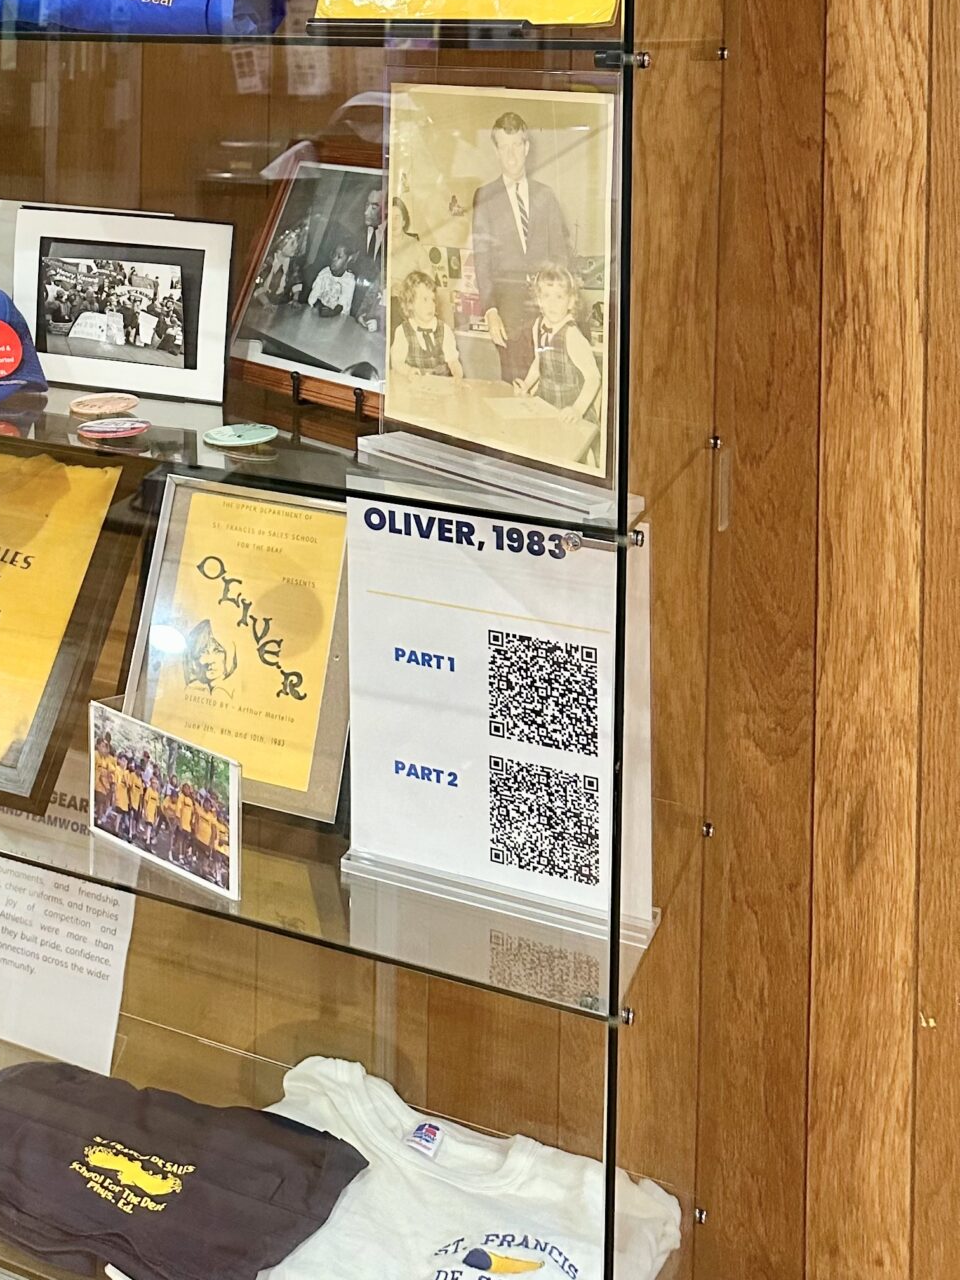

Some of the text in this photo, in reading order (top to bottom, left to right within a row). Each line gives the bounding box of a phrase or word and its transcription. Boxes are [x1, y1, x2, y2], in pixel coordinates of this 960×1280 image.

[236, 503, 257, 512] UPPER
[260, 508, 302, 519] DEPARTMENT
[268, 531, 318, 544] SALES SCHOOL
[364, 507, 567, 560] OLIVER, 1983
[282, 577, 316, 588] PRESENTS
[197, 555, 306, 701] OLIVER
[394, 647, 456, 672] PART 1
[394, 759, 459, 787] PART 2
[4, 882, 119, 921] cheer trophies
[1, 924, 18, 940] they
[20, 930, 38, 944] built
[44, 907, 117, 936] competition and
[42, 954, 68, 969] across
[71, 959, 84, 971] the
[87, 964, 110, 982] wider
[150, 1156, 165, 1168] DE
[69, 1161, 167, 1211] School For The Deaf
[87, 1181, 133, 1214] Phys. Ed.
[434, 1233, 579, 1280] ST. FRANCIS
